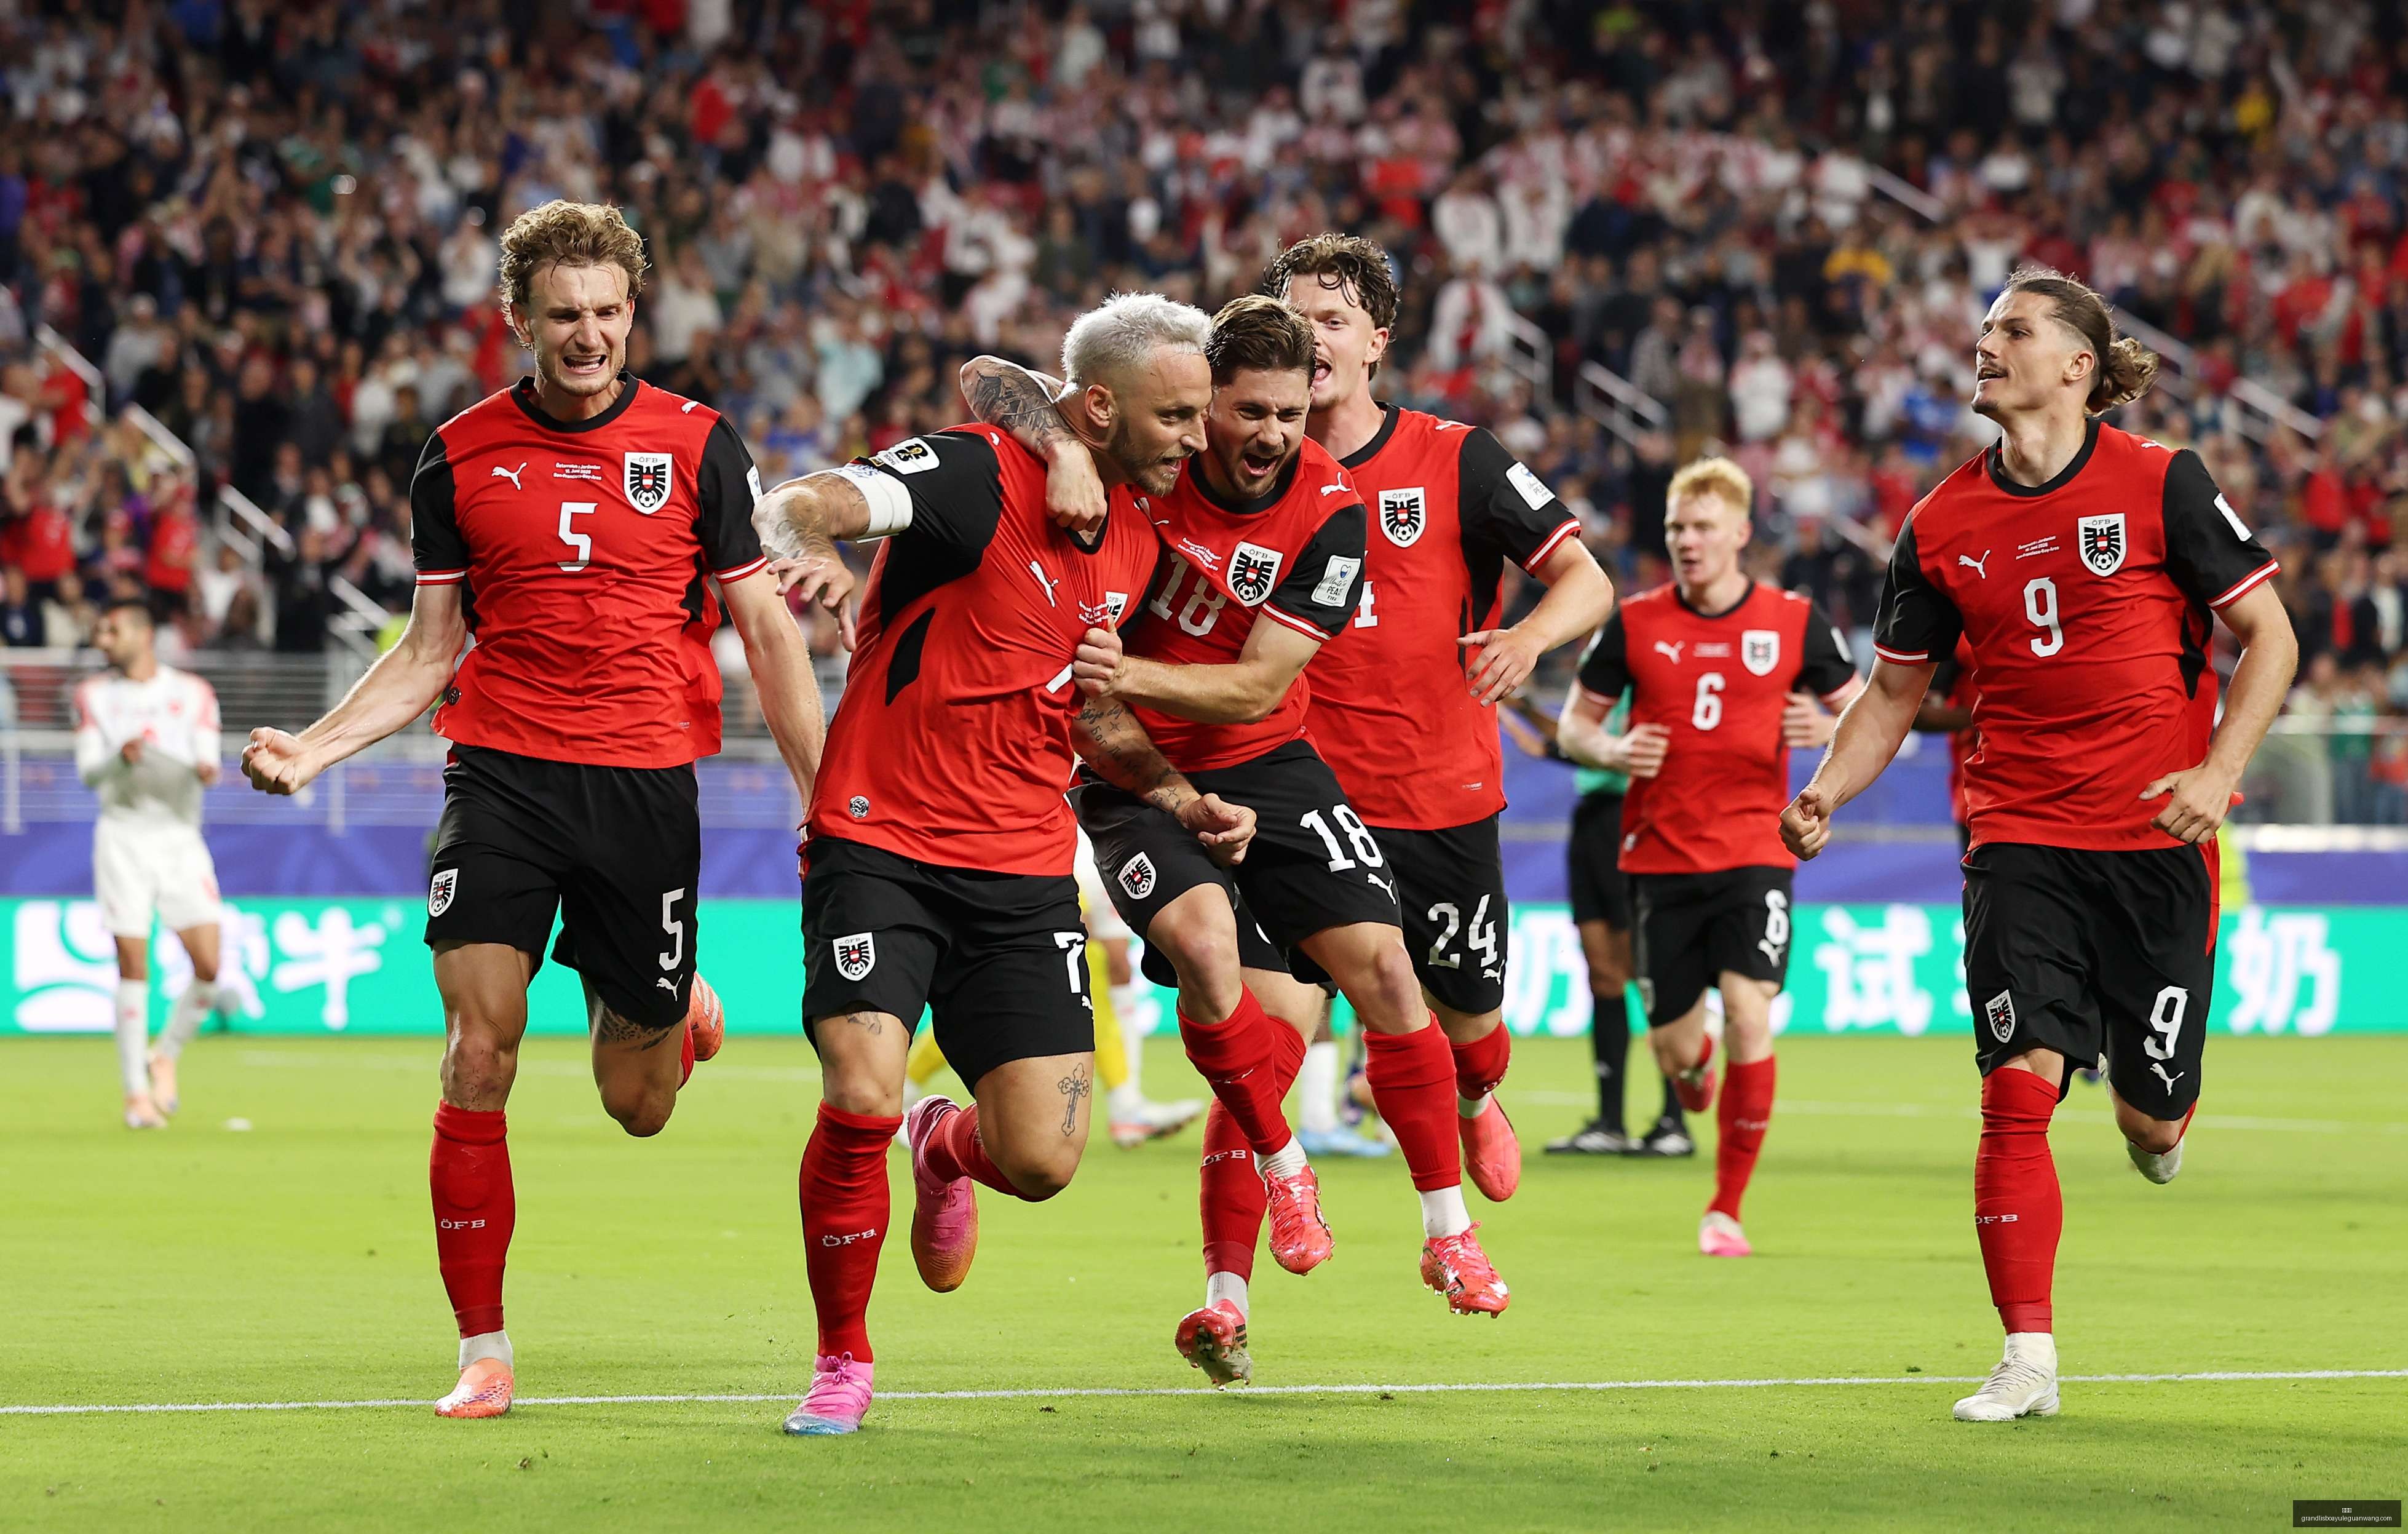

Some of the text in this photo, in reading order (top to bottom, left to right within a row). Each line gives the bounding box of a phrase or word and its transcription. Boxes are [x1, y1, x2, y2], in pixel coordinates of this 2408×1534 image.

[557, 502, 599, 571] 5
[1148, 552, 1228, 636] 18
[2023, 577, 2064, 658] 9
[1692, 672, 1726, 731] 6
[1300, 803, 1384, 873] 18
[659, 888, 685, 971] 5
[1427, 894, 1498, 969] 24
[1765, 889, 1789, 945] 6
[1054, 932, 1085, 994] 7
[2144, 985, 2189, 1060] 9
[440, 1218, 485, 1230] ÖFB
[822, 1228, 877, 1247] ÖFB
